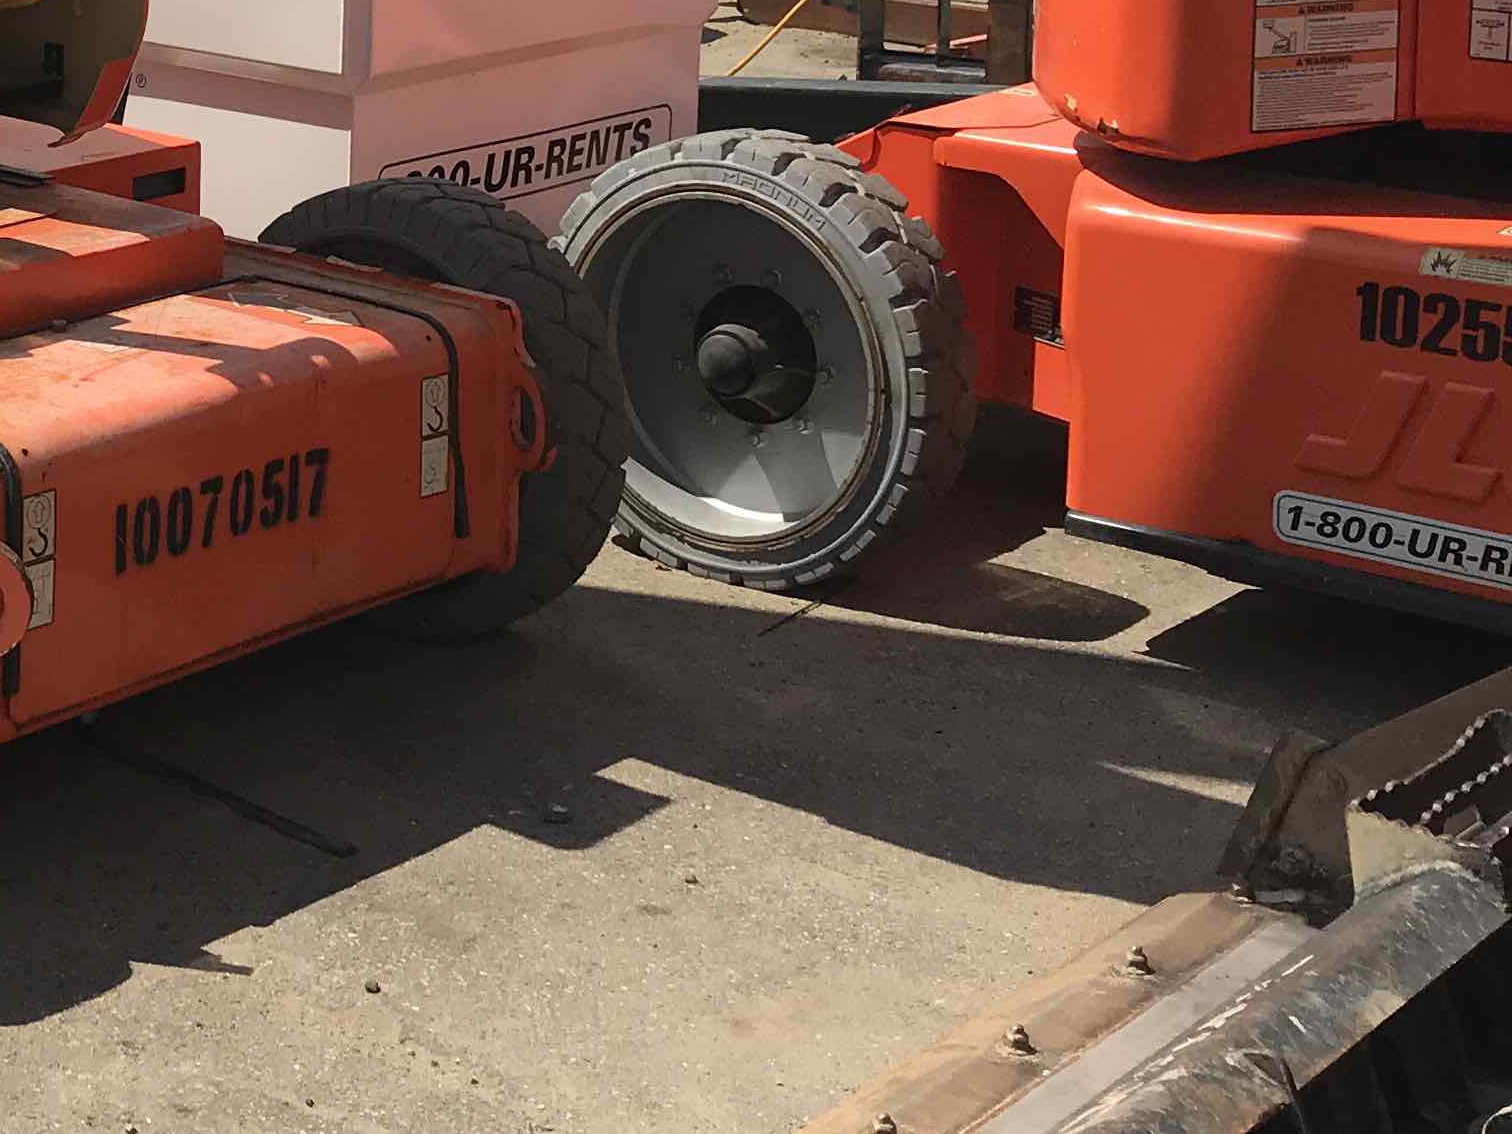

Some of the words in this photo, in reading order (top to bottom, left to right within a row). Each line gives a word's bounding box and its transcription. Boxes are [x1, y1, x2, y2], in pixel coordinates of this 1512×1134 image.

[406, 117, 652, 193] 0-UR-RENTS
[1356, 281, 1512, 366] 1025
[1292, 370, 1512, 505] JL
[114, 447, 330, 577] 10070517
[1287, 504, 1512, 577] 1-800-UR-R
